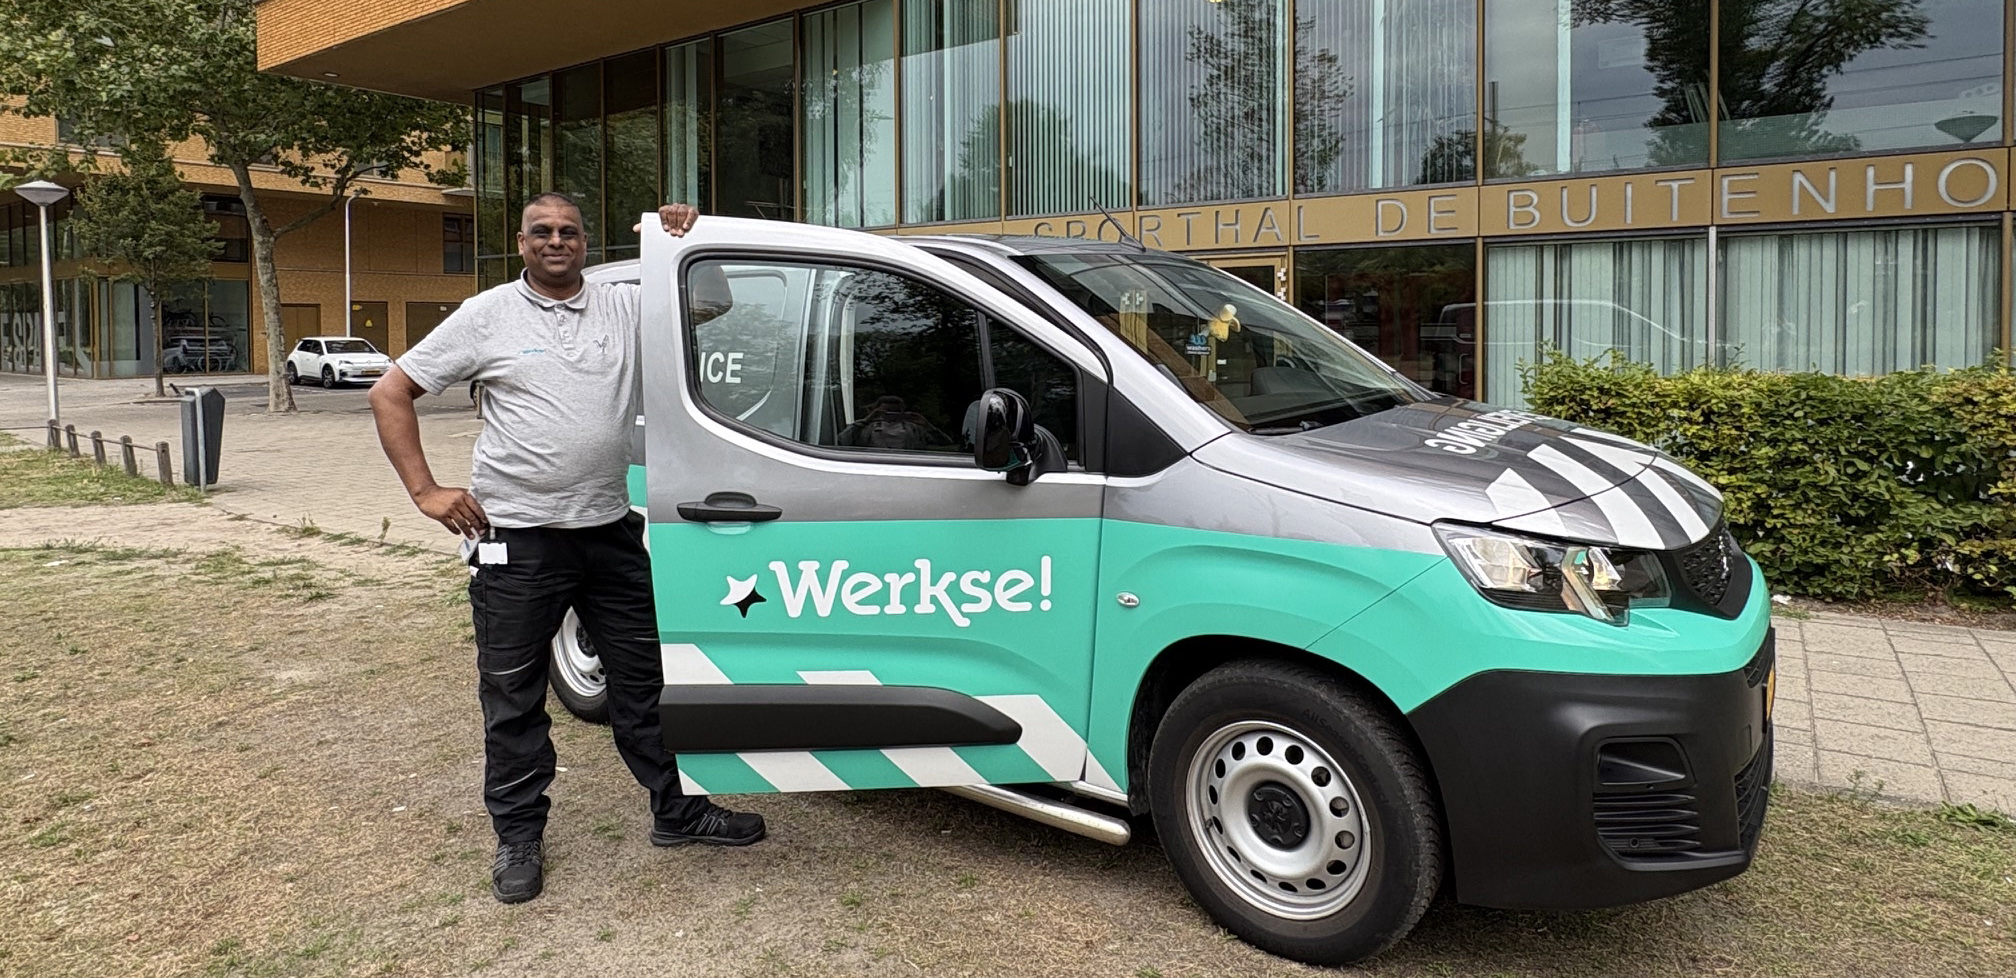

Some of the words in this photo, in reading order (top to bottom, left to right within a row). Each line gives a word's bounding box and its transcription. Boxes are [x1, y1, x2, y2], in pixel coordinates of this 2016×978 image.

[1034, 205, 1320, 247] SPORTHAL
[1375, 194, 1459, 237] DE
[1506, 157, 1998, 230] BUITENHO
[700, 351, 744, 384] ICE
[768, 555, 1052, 628] Werkse!
